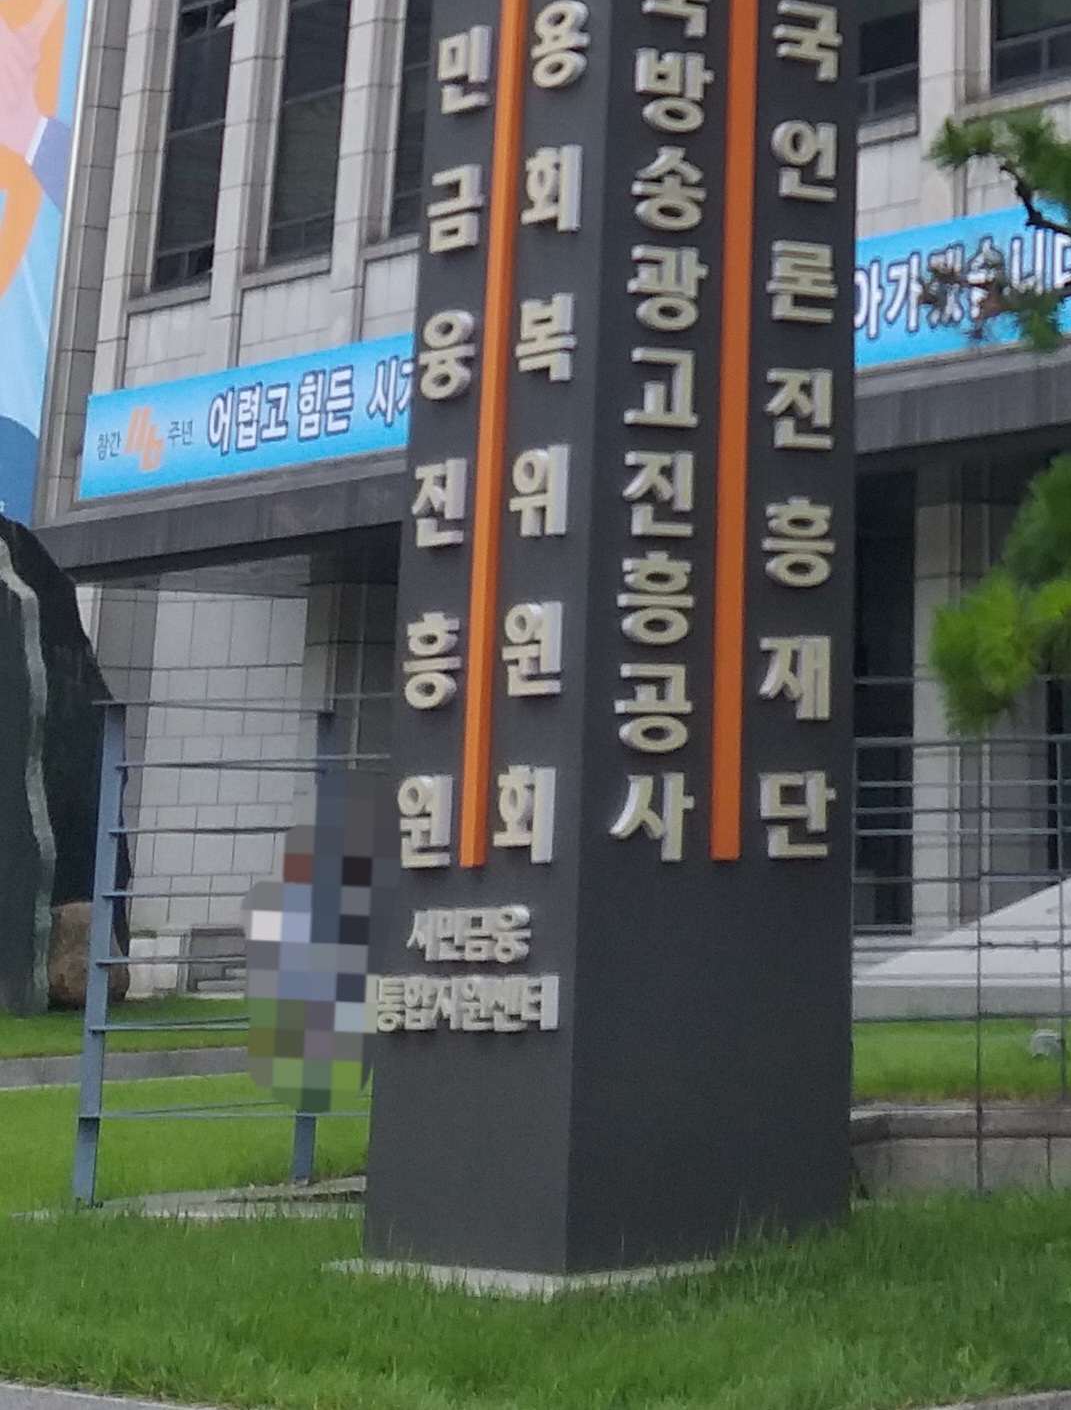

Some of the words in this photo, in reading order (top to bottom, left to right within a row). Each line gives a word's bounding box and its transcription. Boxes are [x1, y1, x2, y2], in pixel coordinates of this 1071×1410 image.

[166, 418, 194, 447] 주년
[206, 381, 291, 457] 어렵고
[297, 363, 355, 442] 힘든
[406, 904, 533, 964] 서민금융
